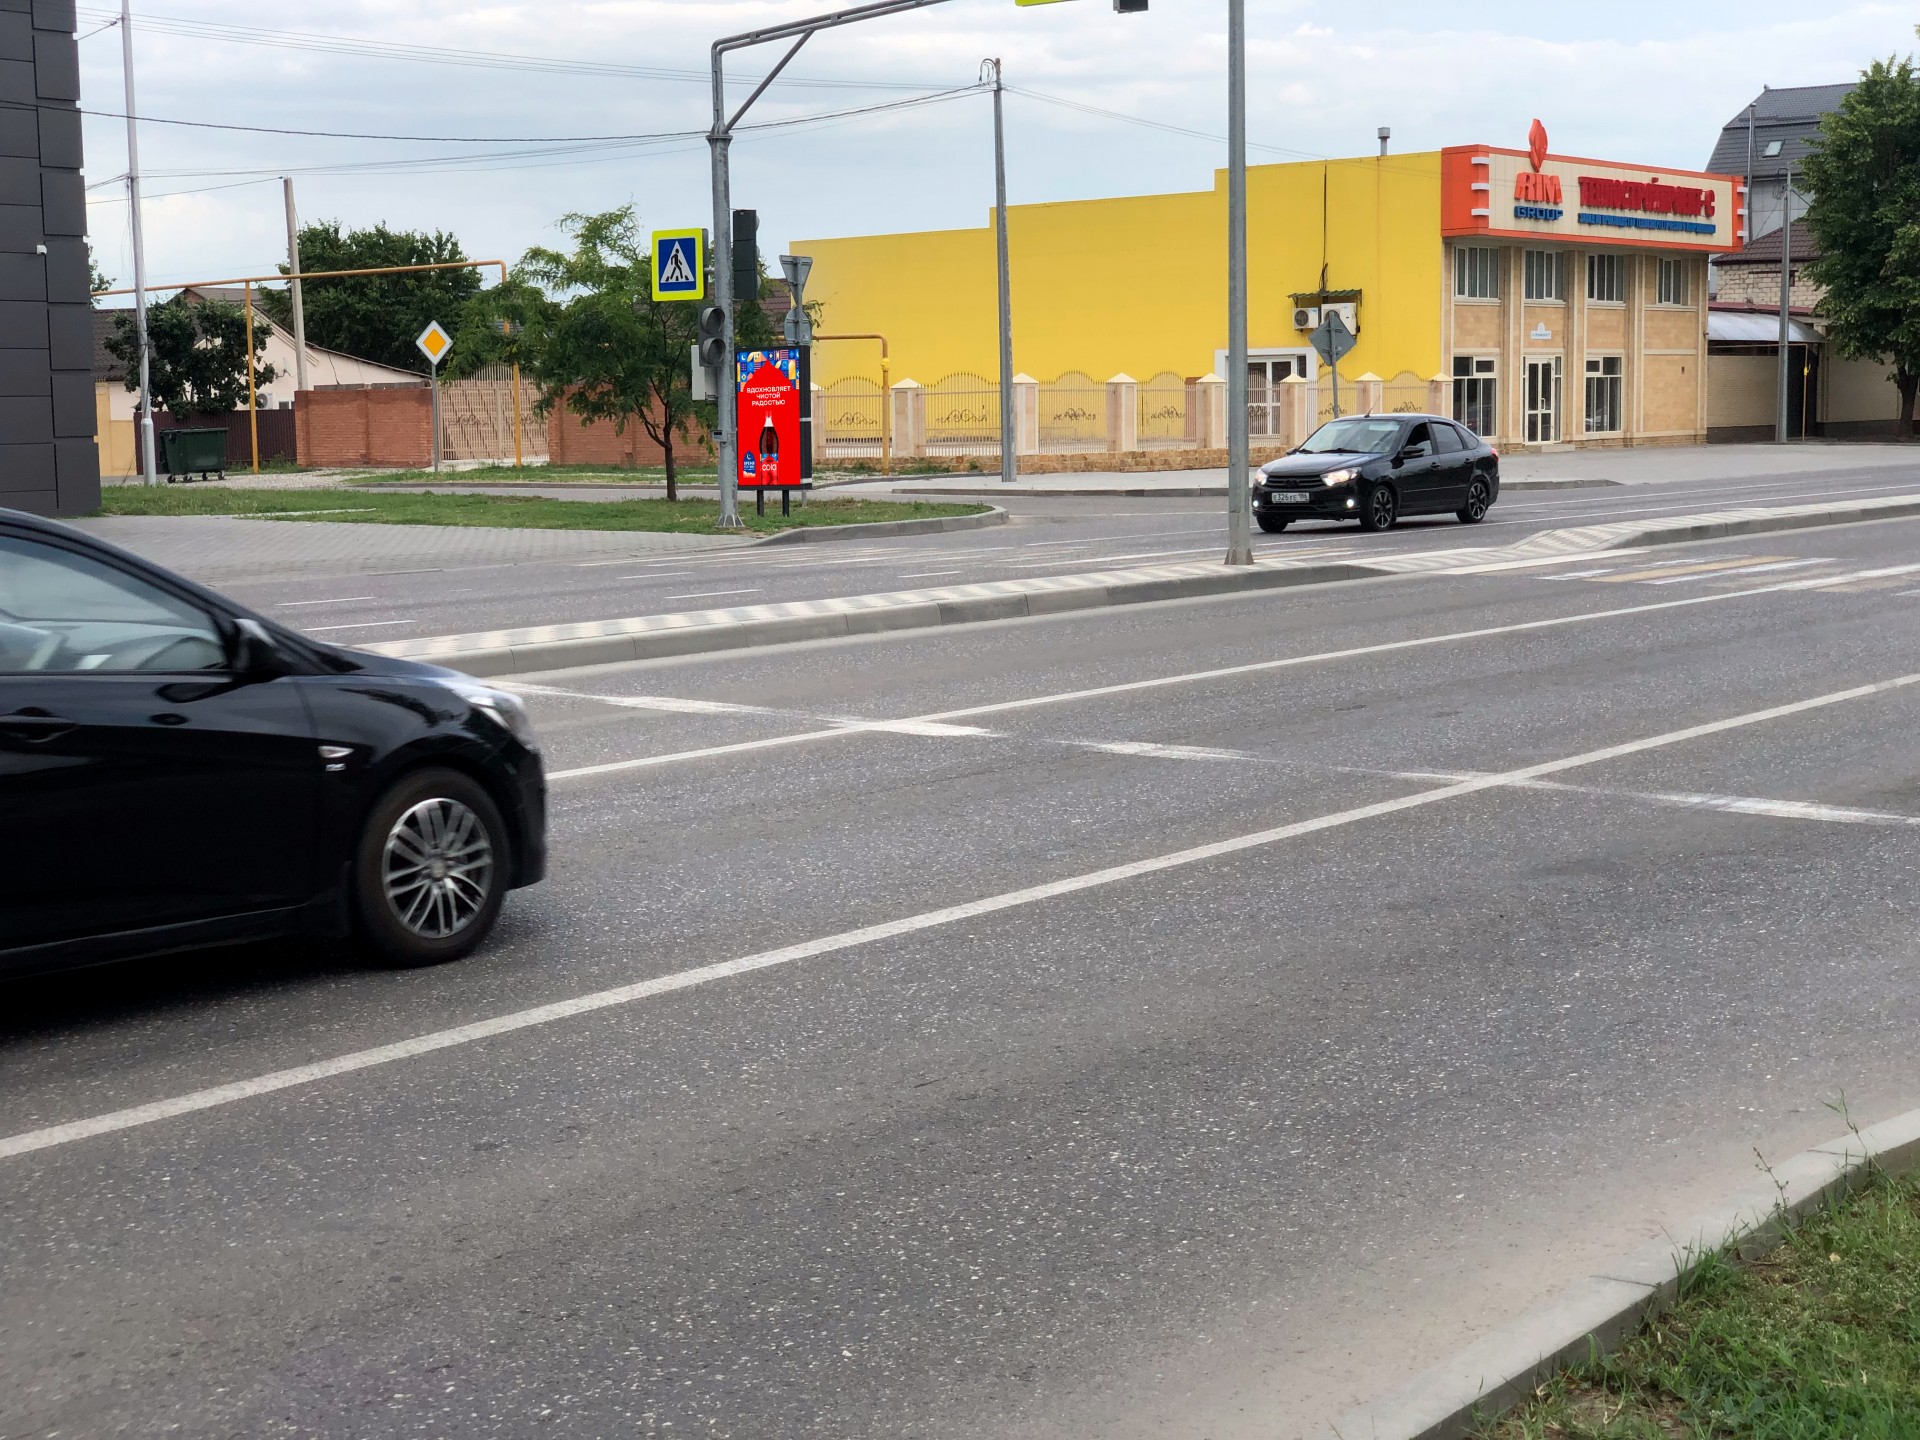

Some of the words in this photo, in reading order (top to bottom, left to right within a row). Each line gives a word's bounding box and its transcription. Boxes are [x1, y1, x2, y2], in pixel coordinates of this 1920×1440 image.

[1514, 172, 1563, 204] RIM
[1514, 206, 1563, 220] GROUP
[746, 386, 791, 394] ВДОХНОВЛЯЕТ
